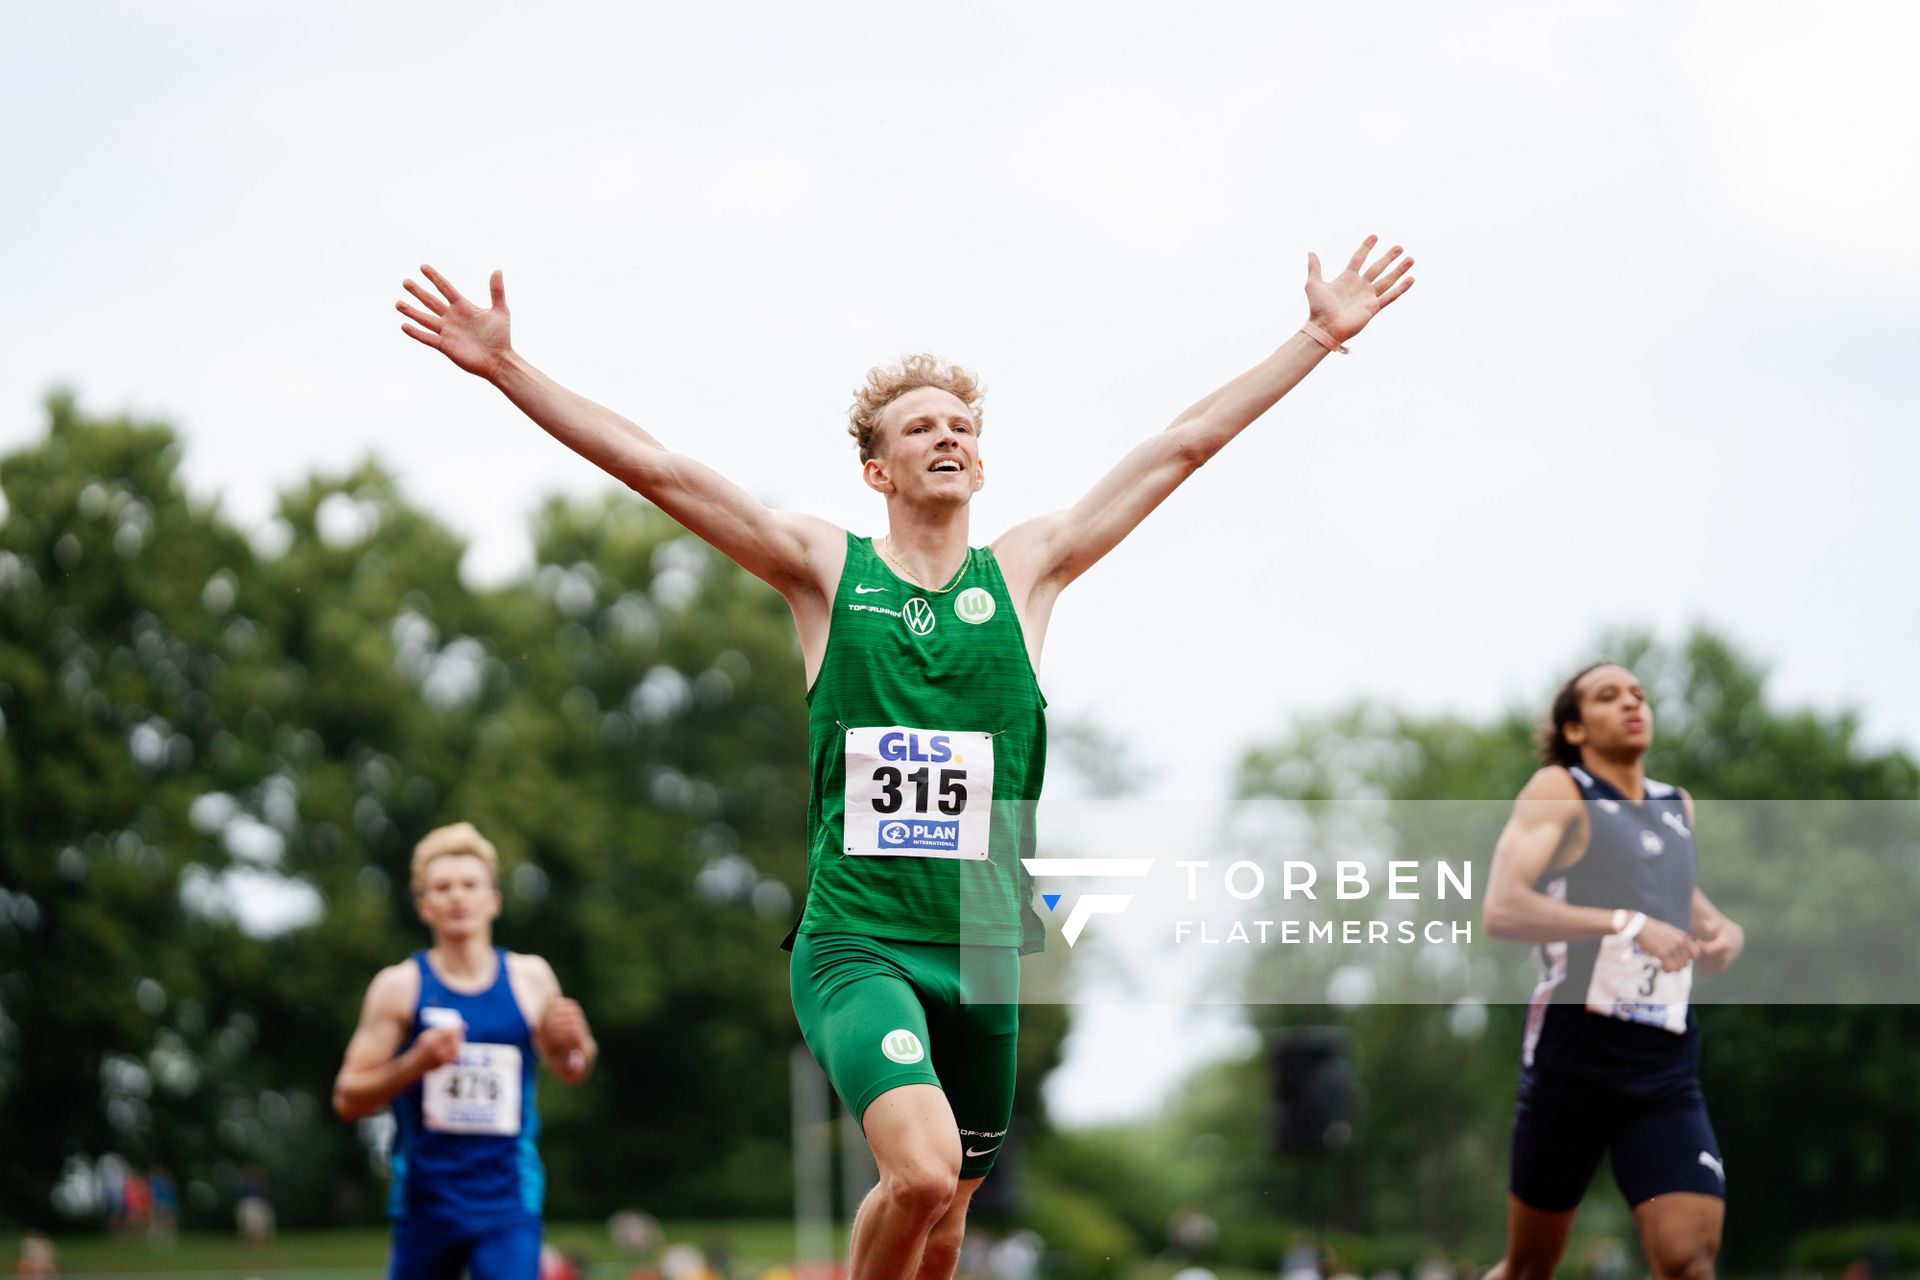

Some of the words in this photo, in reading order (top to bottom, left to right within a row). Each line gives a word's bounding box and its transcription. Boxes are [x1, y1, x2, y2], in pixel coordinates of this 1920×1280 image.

[871, 766, 968, 816] 315
[913, 825, 956, 840] PLAN
[913, 839, 956, 847] INTERNATIONAL
